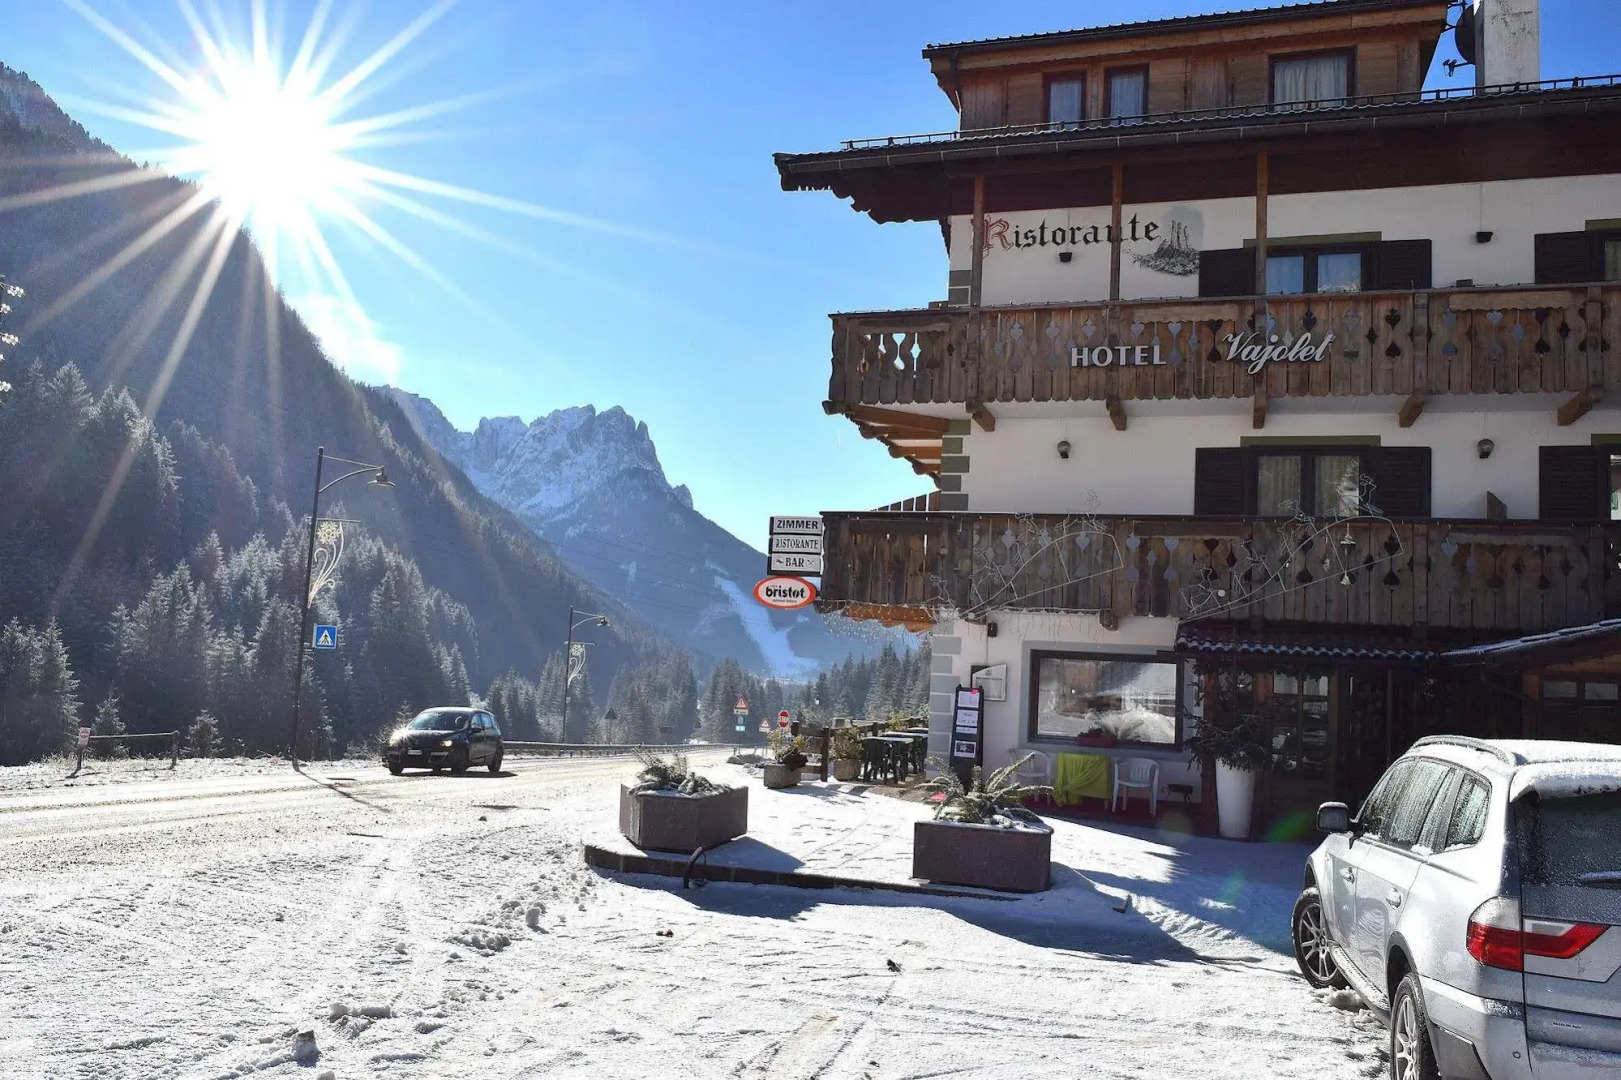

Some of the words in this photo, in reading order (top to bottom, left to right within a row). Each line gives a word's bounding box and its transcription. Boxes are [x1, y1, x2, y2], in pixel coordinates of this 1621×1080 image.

[1071, 345, 1167, 367] HOTEL
[1222, 332, 1335, 374] Vajolet
[776, 519, 818, 529] ZIMMER
[775, 538, 819, 549] RISTORANTE
[785, 557, 804, 567] BAR
[766, 585, 805, 598] bristot
